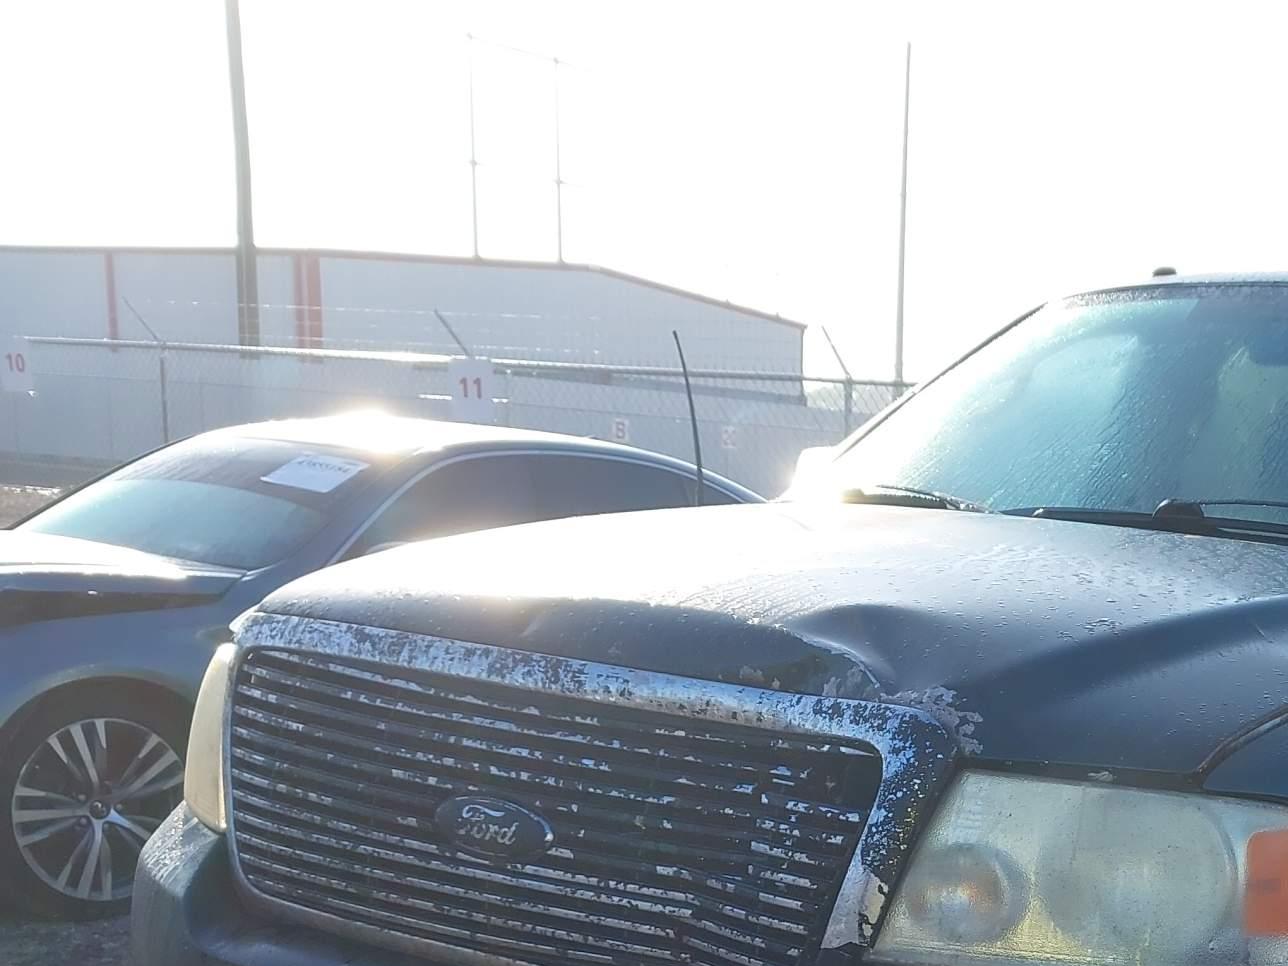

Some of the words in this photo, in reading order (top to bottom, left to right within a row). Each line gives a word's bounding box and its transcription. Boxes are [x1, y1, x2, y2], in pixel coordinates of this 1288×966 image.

[5, 352, 25, 372] 10
[459, 376, 482, 399] 11
[456, 804, 520, 846] Ford
